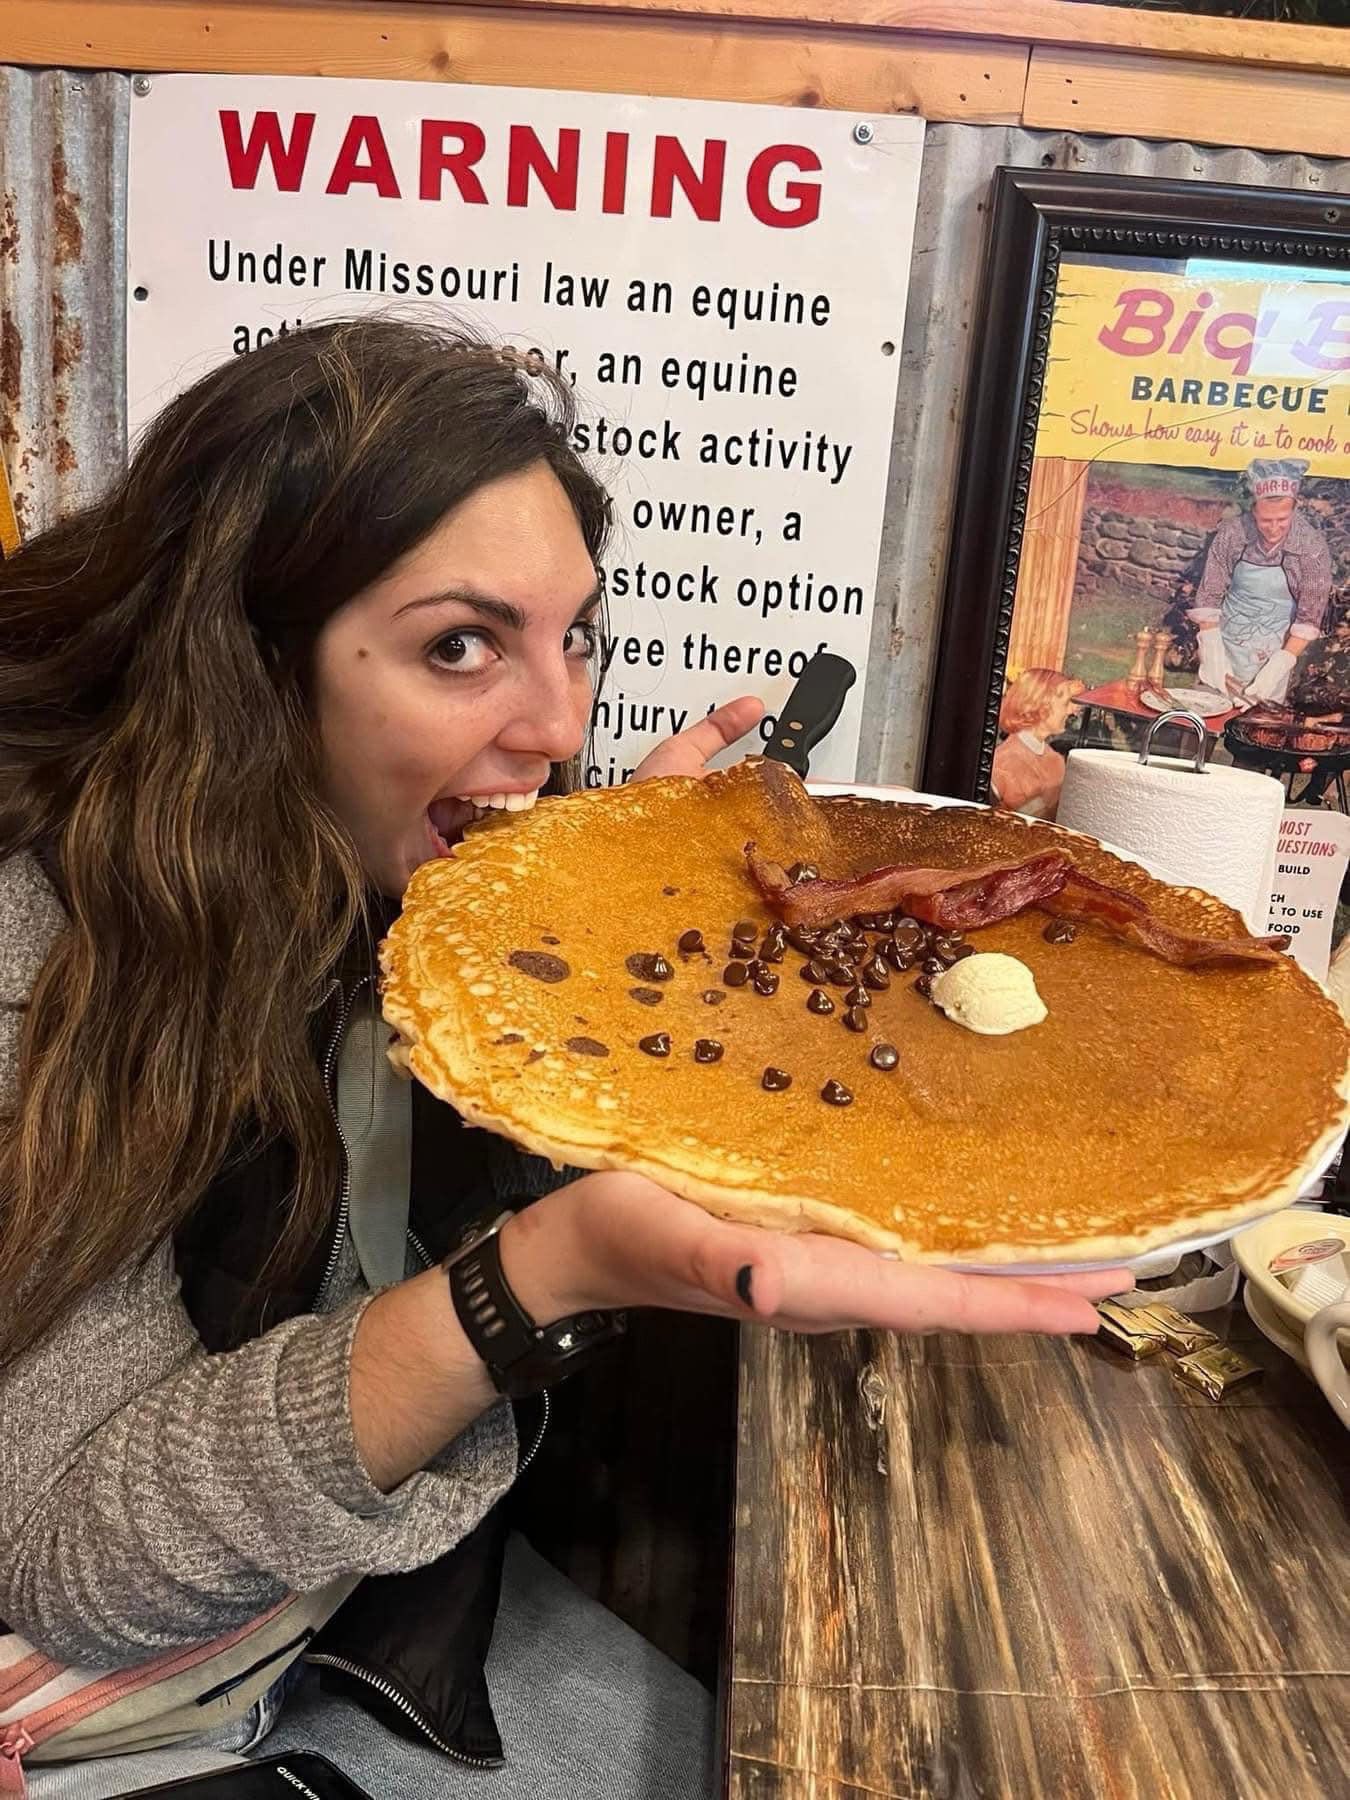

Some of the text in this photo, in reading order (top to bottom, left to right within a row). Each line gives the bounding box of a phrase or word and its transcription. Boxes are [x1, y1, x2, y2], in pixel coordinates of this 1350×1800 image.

[218, 110, 823, 229] WARNING
[208, 239, 831, 330] Under Missouri law an equine
[1097, 288, 1280, 376] Big
[597, 351, 642, 385] an
[661, 353, 798, 401] equine
[1131, 375, 1329, 413] BARBECUE
[1070, 403, 1338, 456] Shows how easy it is to cook
[699, 428, 853, 484] activity
[632, 499, 802, 545] owner, a
[736, 573, 864, 618] option
[1278, 864, 1311, 875] BUILD
[1270, 893, 1285, 903] CH
[1281, 907, 1297, 917] TO
[1302, 909, 1324, 919] USE
[1268, 923, 1301, 934] FOOD
[277, 1766, 307, 1790] QUICK
